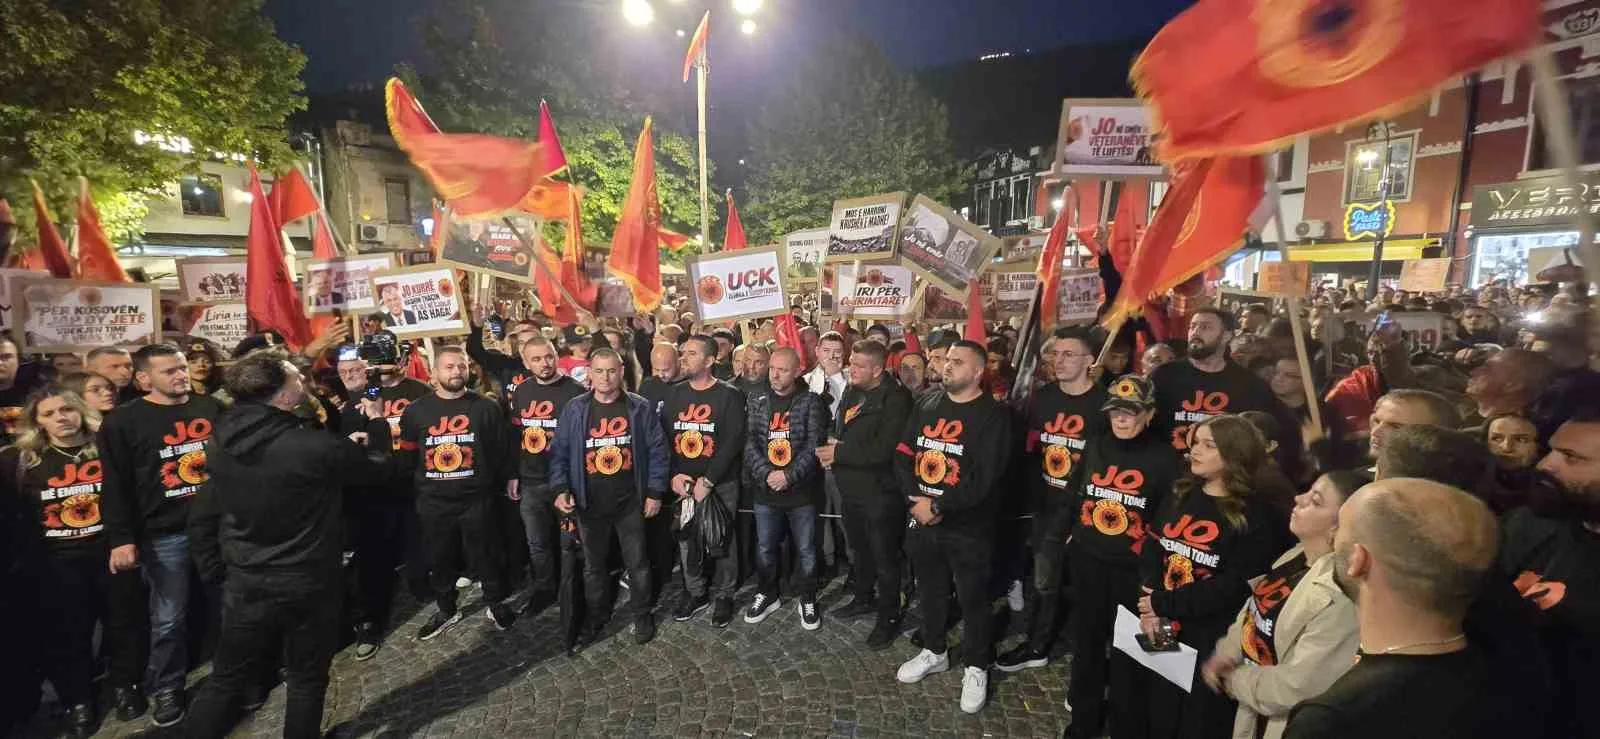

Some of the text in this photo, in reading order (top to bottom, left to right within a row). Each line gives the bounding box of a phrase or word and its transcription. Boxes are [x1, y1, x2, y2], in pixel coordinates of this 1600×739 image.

[1091, 117, 1116, 136] JO
[402, 285, 411, 298] JO
[417, 310, 429, 321] AS
[521, 400, 554, 418] JO
[1182, 390, 1229, 411] JO
[679, 403, 712, 421] JO
[163, 418, 212, 445] JO
[428, 415, 470, 435] JO
[591, 416, 628, 438] JO
[923, 418, 963, 439] JO
[1044, 412, 1084, 434] JO
[48, 459, 103, 488] JO
[1091, 465, 1144, 491] JO
[1163, 514, 1219, 544] JO
[1191, 549, 1220, 568] TONË
